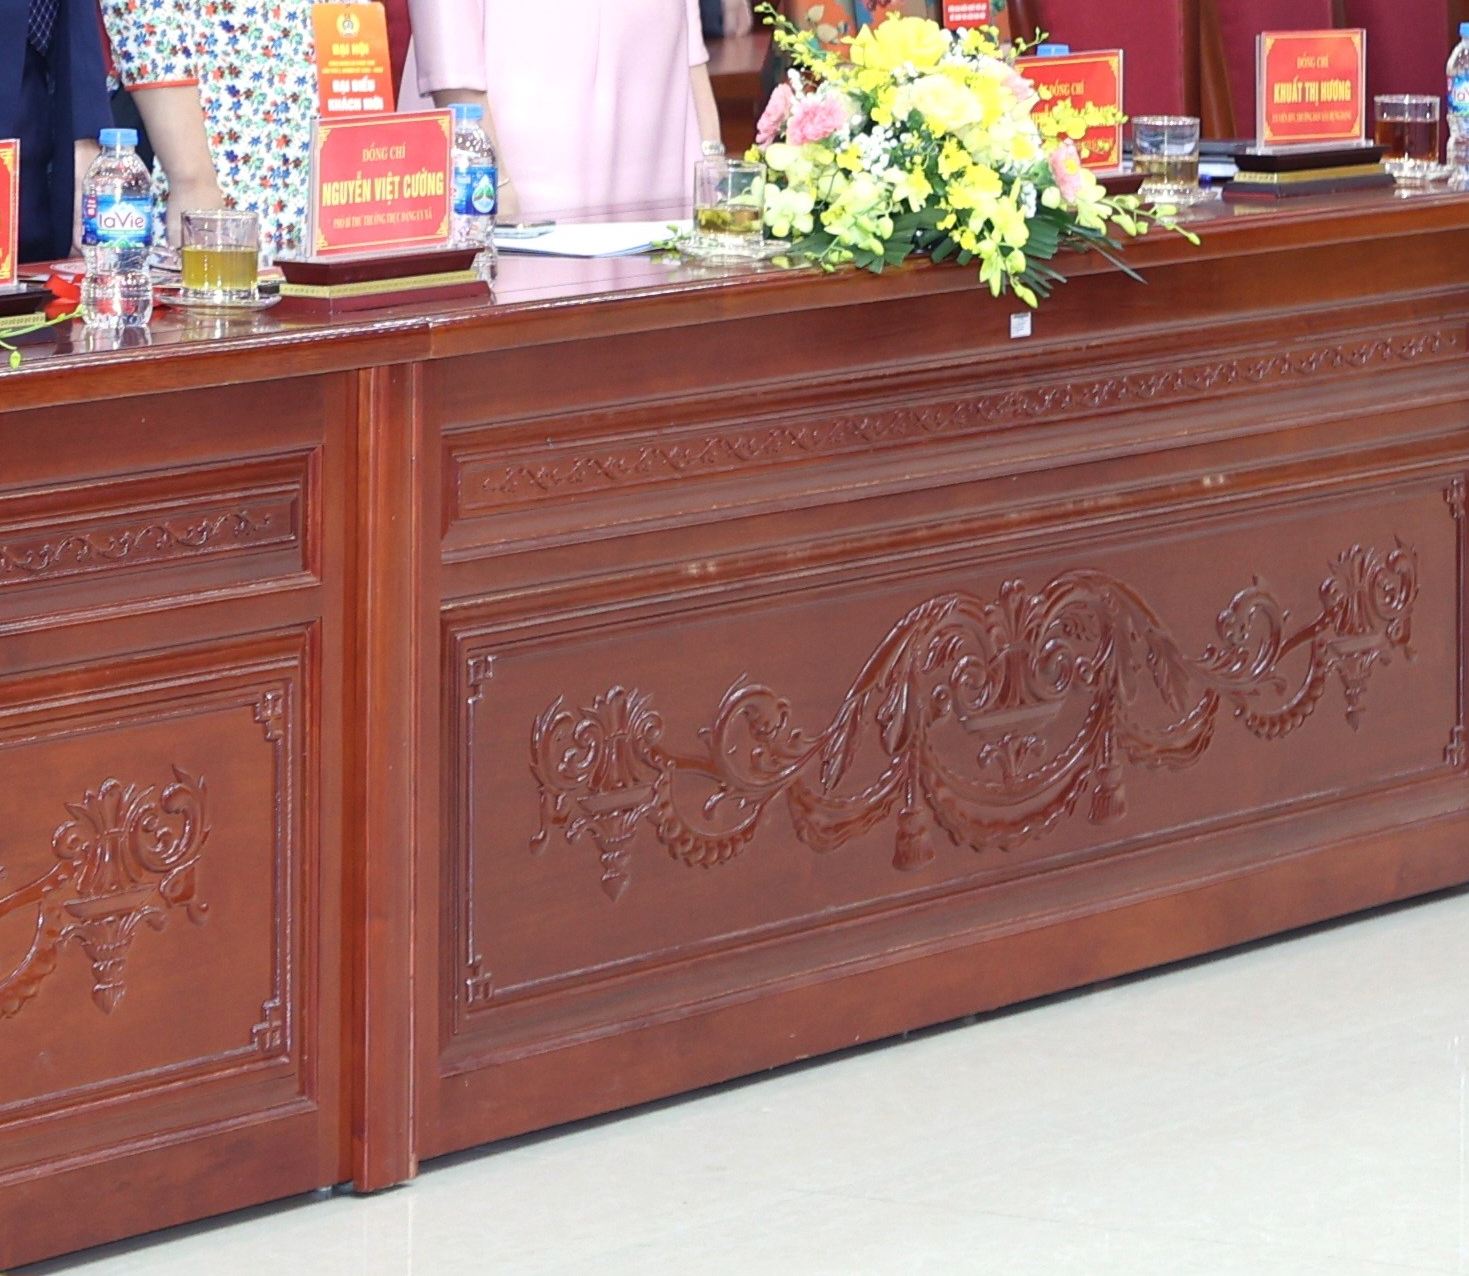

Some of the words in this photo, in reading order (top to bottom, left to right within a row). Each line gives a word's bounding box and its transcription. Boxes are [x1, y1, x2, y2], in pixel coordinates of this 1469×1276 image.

[1304, 81, 1319, 107] THỊ
[322, 170, 372, 207] NGUYỄN
[374, 170, 401, 206] VIỆT
[403, 166, 444, 199] CƯỜNG
[99, 211, 144, 228] laVie
